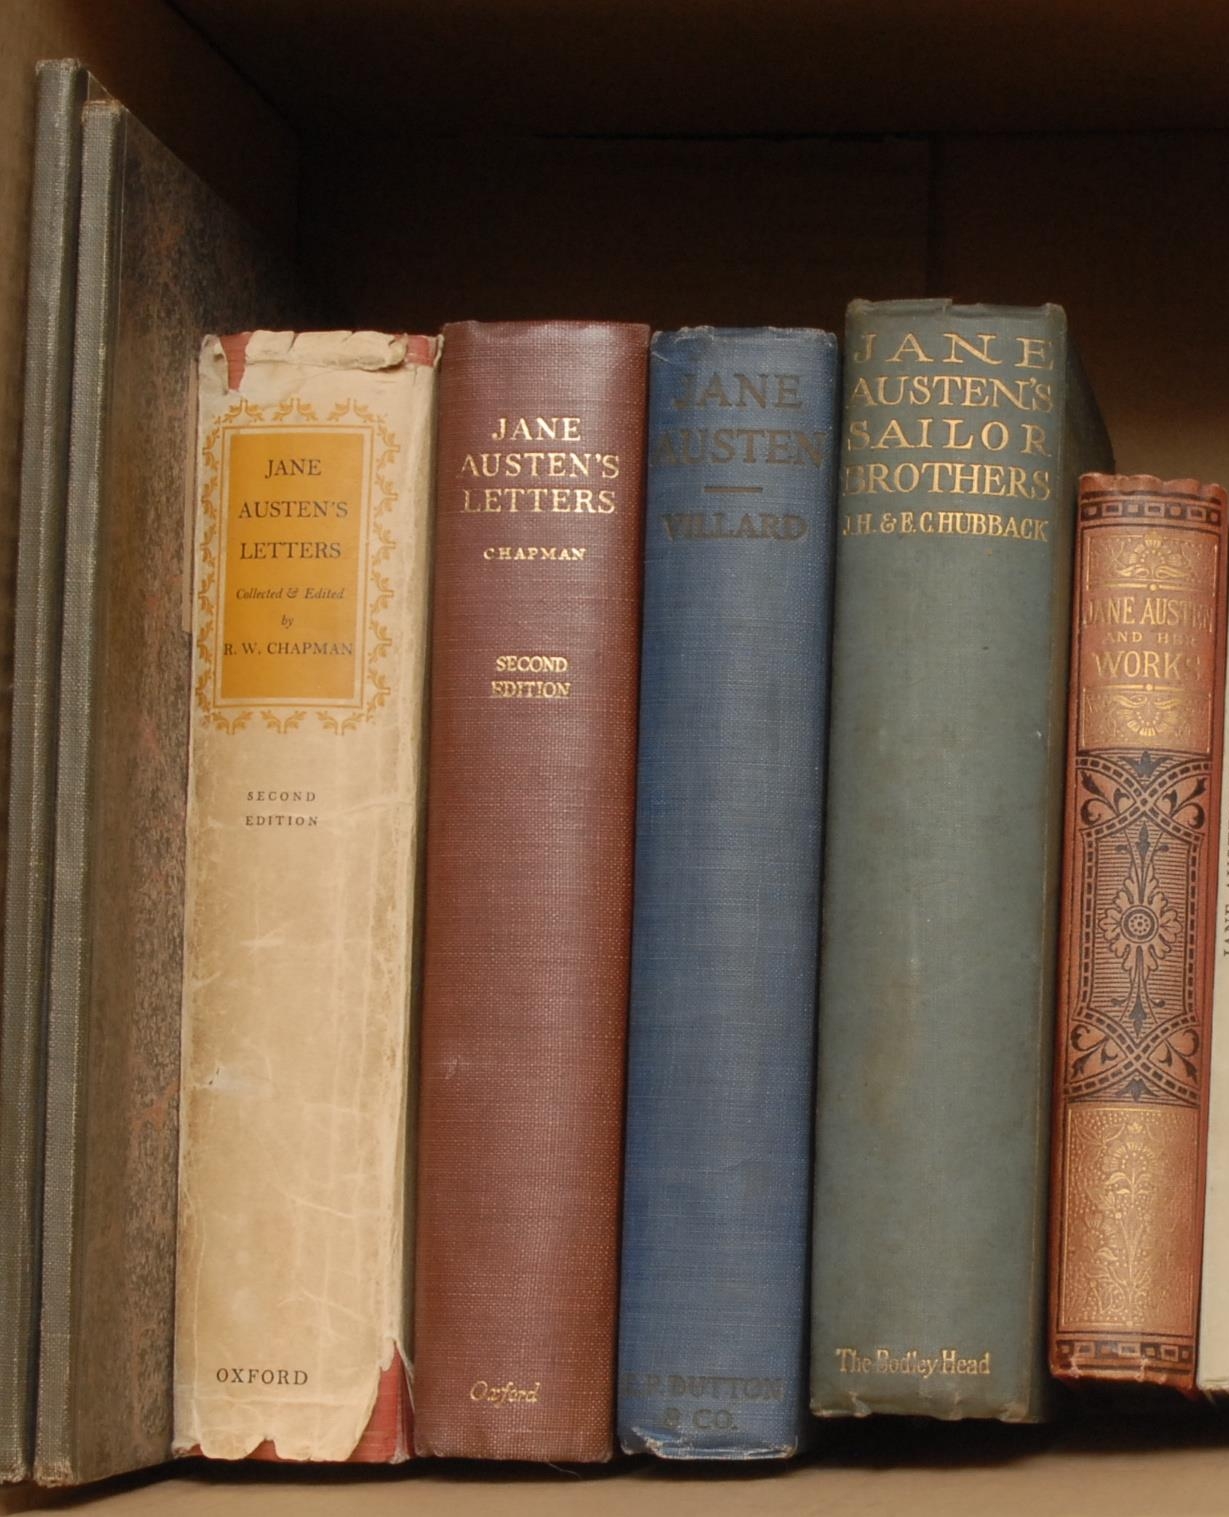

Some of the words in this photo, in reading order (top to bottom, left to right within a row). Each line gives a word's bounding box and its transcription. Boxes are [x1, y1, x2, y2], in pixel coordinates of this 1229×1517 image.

[853, 332, 1054, 371] JANE
[673, 372, 803, 409] JANE
[850, 375, 1053, 413] AUSTEN'S
[491, 417, 581, 442] JANE
[847, 418, 1052, 457] SAILOR
[651, 428, 827, 468] AUSTEN
[265, 458, 321, 479] JANE
[460, 453, 620, 480] AUSTEN'S
[842, 462, 1052, 500] BROTHERS
[238, 500, 349, 519] AUSTEN'S
[462, 489, 617, 514] LETTERS
[661, 512, 809, 542] VILLARD
[880, 512, 896, 533] &
[938, 512, 1048, 542] HUBBACK
[240, 542, 342, 561] LETTERS
[483, 547, 587, 560] CHAPMAN
[235, 587, 283, 601] Collected
[285, 587, 299, 600] &
[304, 587, 345, 600] Edited
[281, 614, 294, 630] by
[1082, 596, 1136, 626] JANE
[1140, 596, 1214, 633] AUSTEN
[223, 641, 237, 656] R.
[241, 641, 262, 656] W.
[266, 641, 354, 656] CHAPMAN
[1103, 632, 1143, 644] AND
[495, 656, 568, 672] SECOND
[1093, 650, 1201, 682] WORKS
[491, 681, 571, 698] EDITION
[246, 790, 316, 802] SECOND
[245, 815, 319, 827] EDITION
[835, 1348, 872, 1374] The
[876, 1349, 939, 1379] Bodley
[939, 1350, 991, 1375] Head
[216, 1367, 309, 1386] OXFORD
[469, 1381, 541, 1406] Oxford
[692, 1408, 738, 1430] CO.
